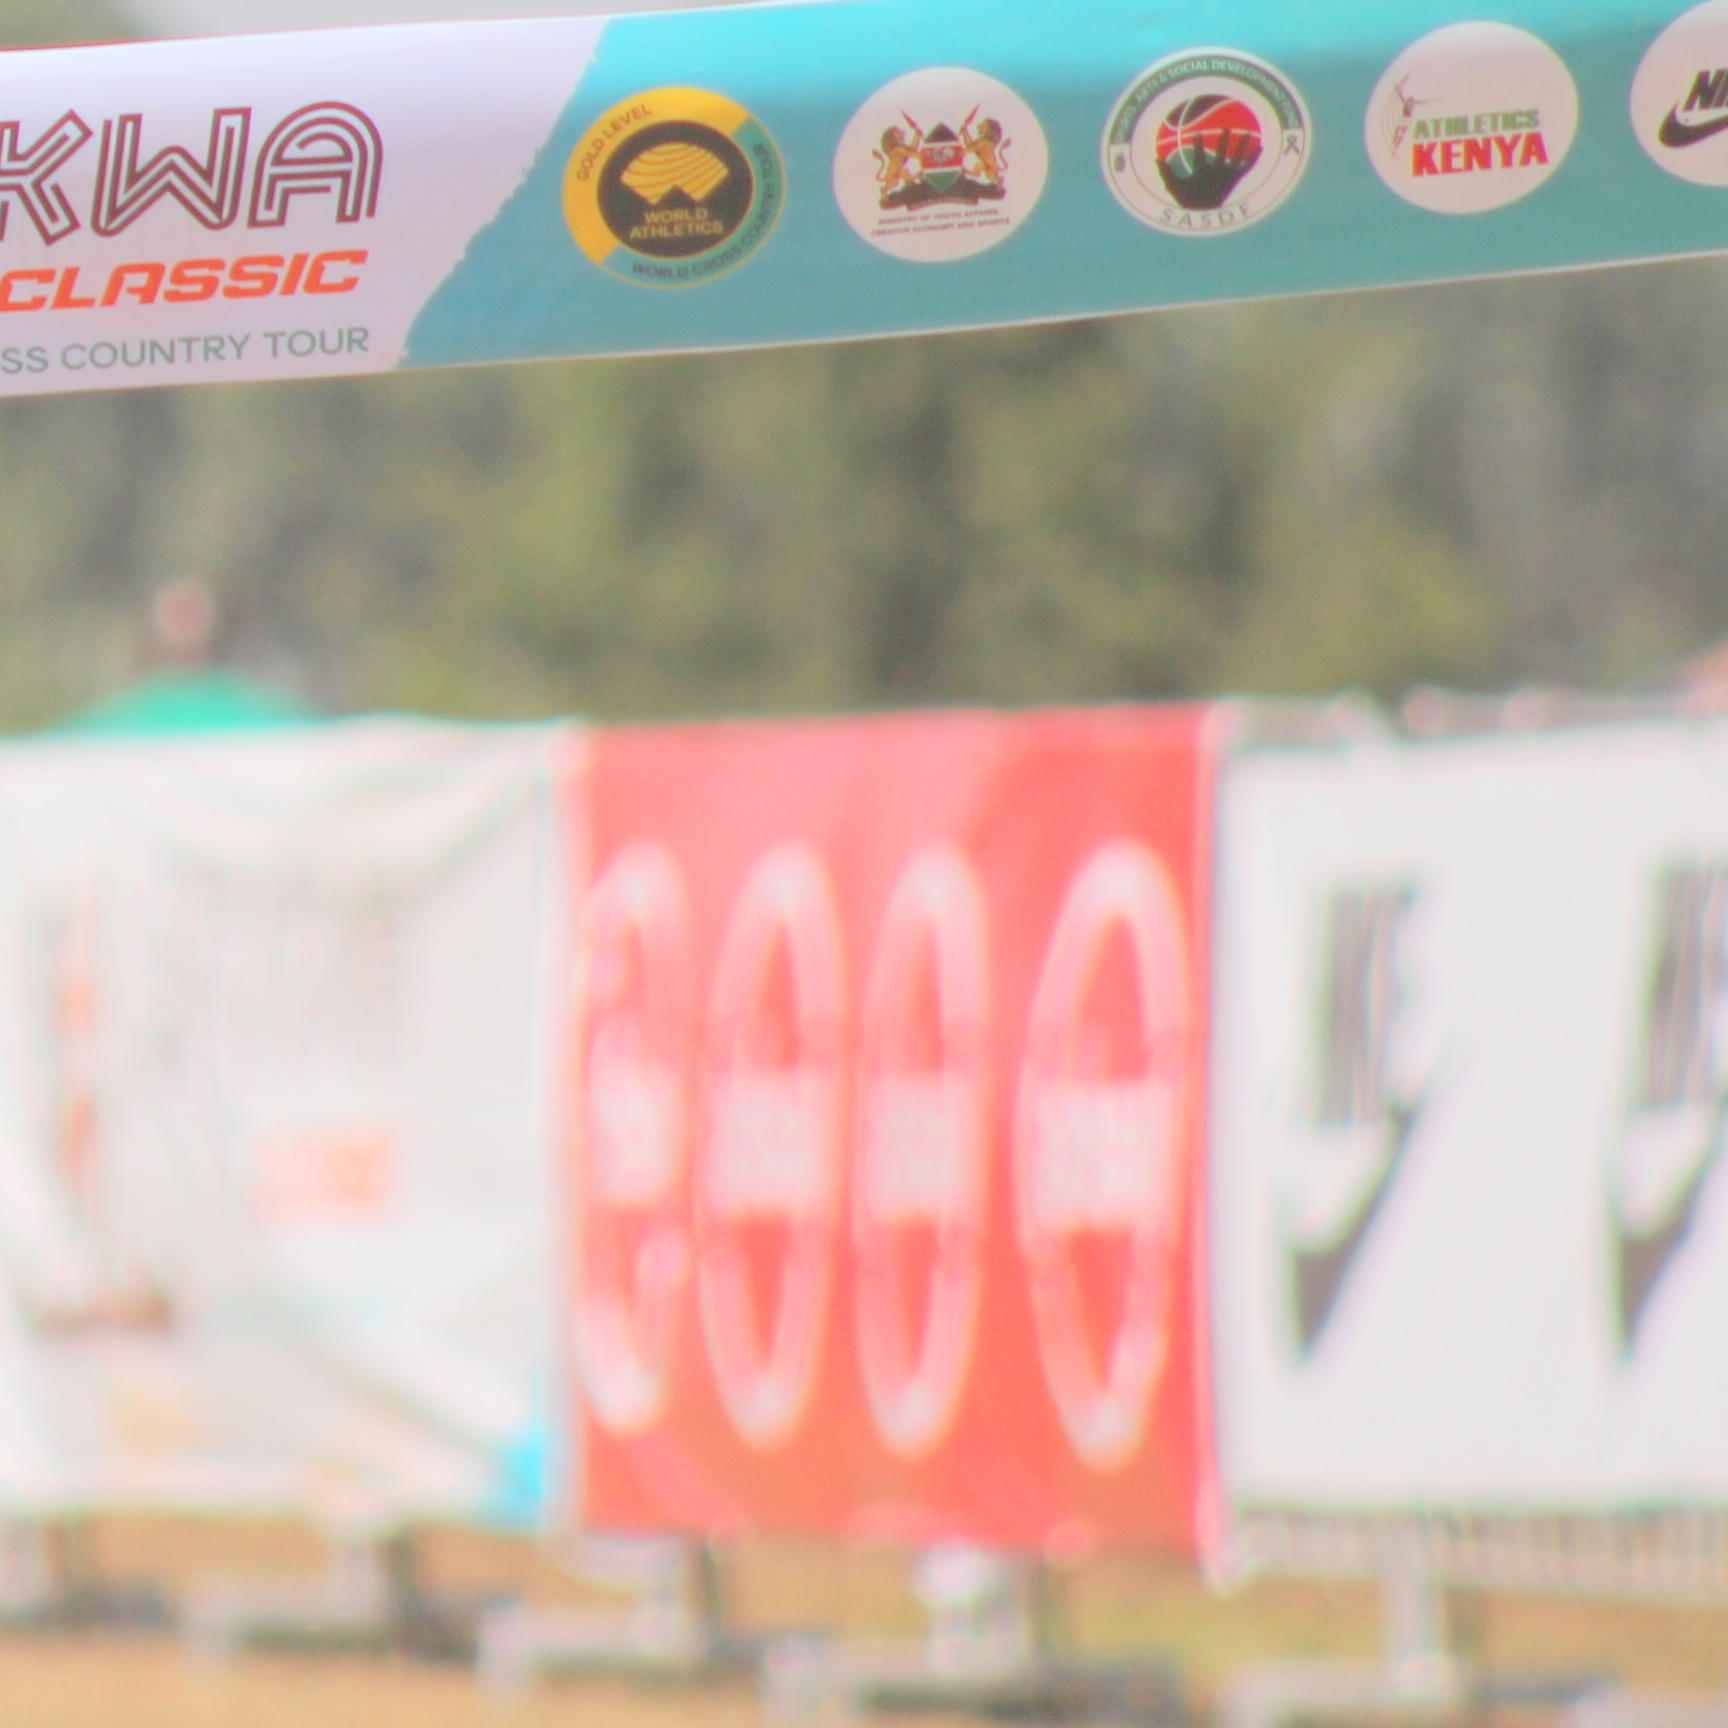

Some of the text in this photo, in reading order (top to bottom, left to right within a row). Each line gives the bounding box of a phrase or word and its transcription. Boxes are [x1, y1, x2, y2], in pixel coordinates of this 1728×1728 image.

[1682, 68, 1728, 112] NI
[576, 103, 653, 181] GOLD LEVEL
[1412, 108, 1540, 140] ATHLETICS
[1412, 132, 1549, 177] KENYA
[629, 220, 724, 240] ATHLETICS
[644, 207, 708, 224] WORLD
[60, 333, 251, 370] COUNTRY
[262, 327, 369, 357] TOUR
